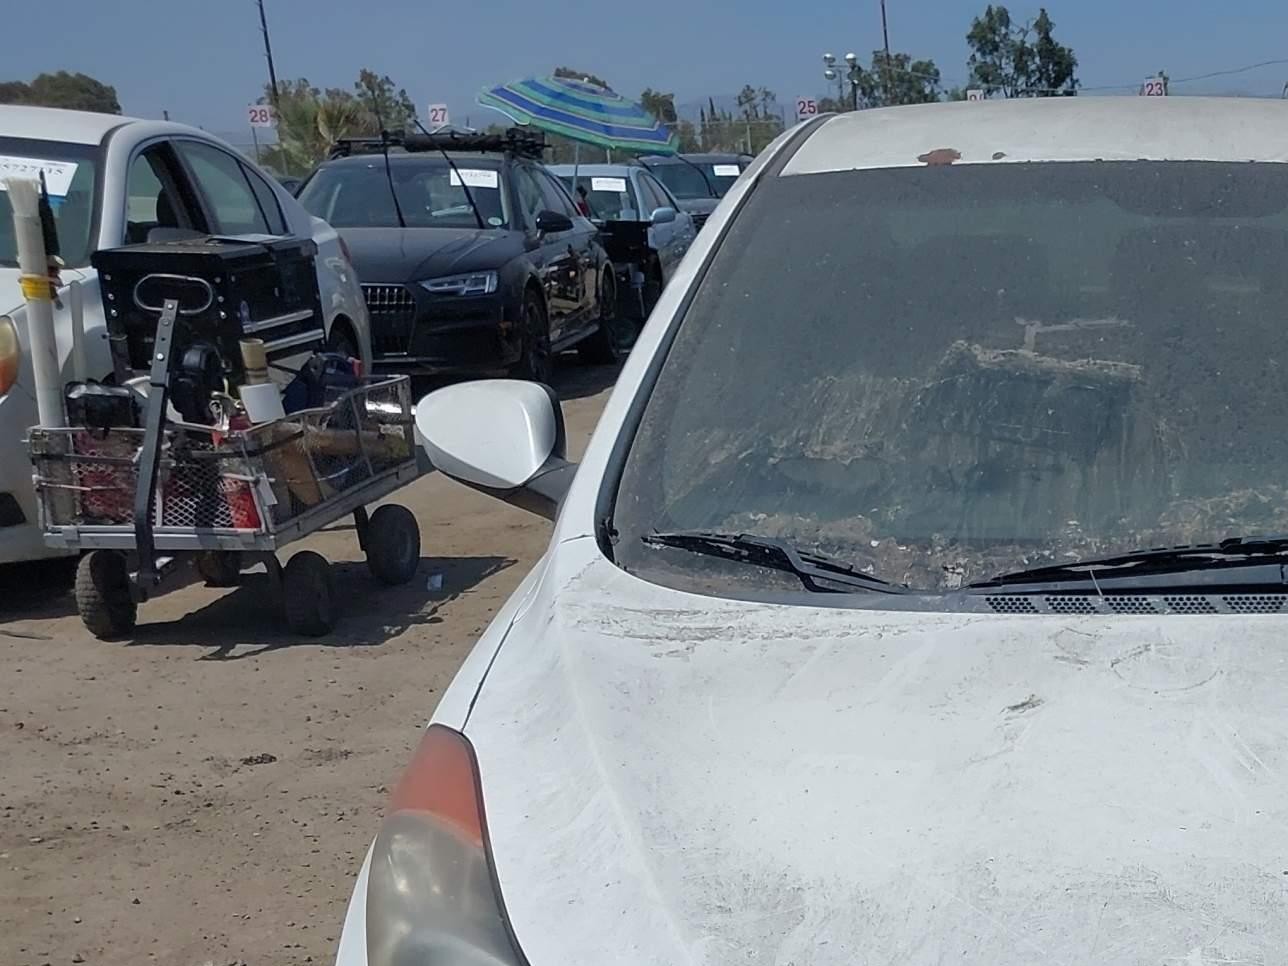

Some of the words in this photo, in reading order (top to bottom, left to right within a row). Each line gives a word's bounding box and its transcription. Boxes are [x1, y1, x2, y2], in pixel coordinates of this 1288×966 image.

[1146, 82, 1163, 96] 23
[798, 100, 816, 115] 25
[249, 109, 269, 123] 28
[430, 108, 446, 122] 27
